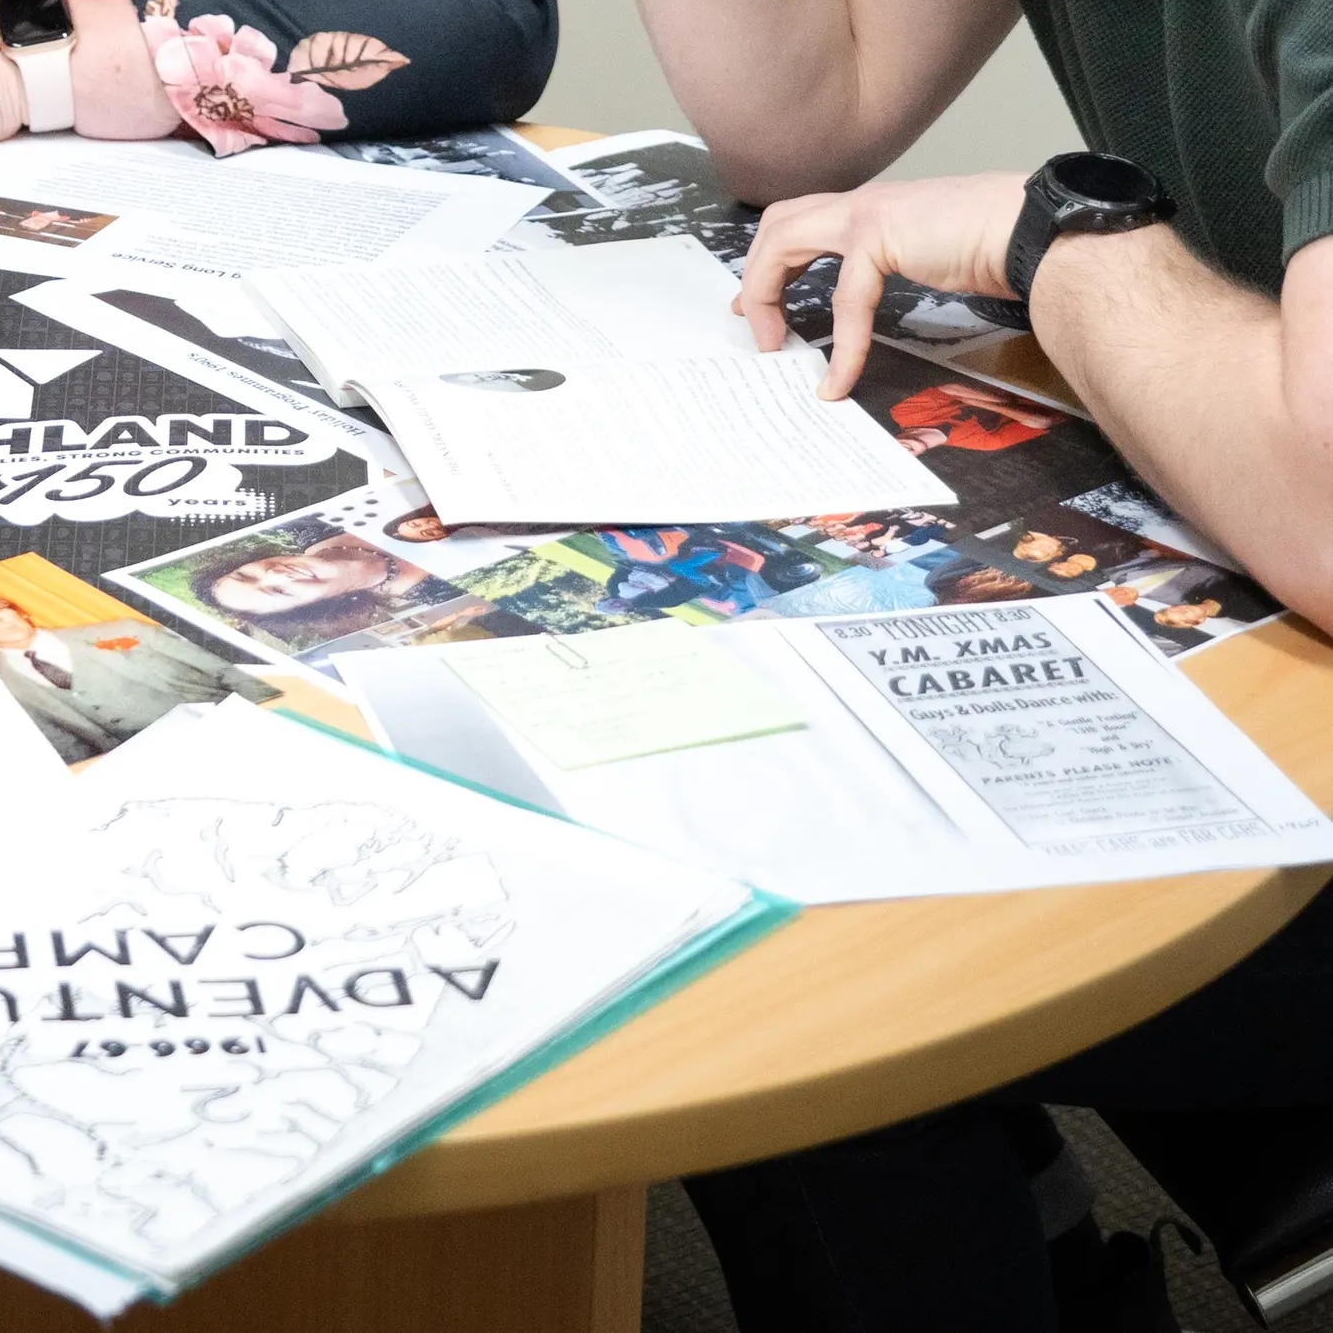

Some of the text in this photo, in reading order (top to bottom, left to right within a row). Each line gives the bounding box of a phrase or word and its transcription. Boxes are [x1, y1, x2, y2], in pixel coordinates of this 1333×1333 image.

[111, 253, 177, 269] Service
[182, 263, 226, 278] Long
[227, 369, 310, 412] Programmes
[308, 409, 367, 437] Holiday
[56, 450, 143, 461] STRONG
[149, 448, 306, 458] COMMUNITIES
[168, 496, 247, 508] years
[834, 609, 1032, 641] 8.30 TONIGHT 8.30
[868, 632, 1053, 667] Y.M. XMAS
[887, 657, 1086, 697] CABARET
[909, 706, 954, 722] Guys
[957, 703, 970, 716] &
[970, 699, 1015, 715] Dolls
[1014, 696, 1073, 710] Dance
[981, 770, 1056, 785] PARENTS
[1062, 763, 1121, 776] PLEASE
